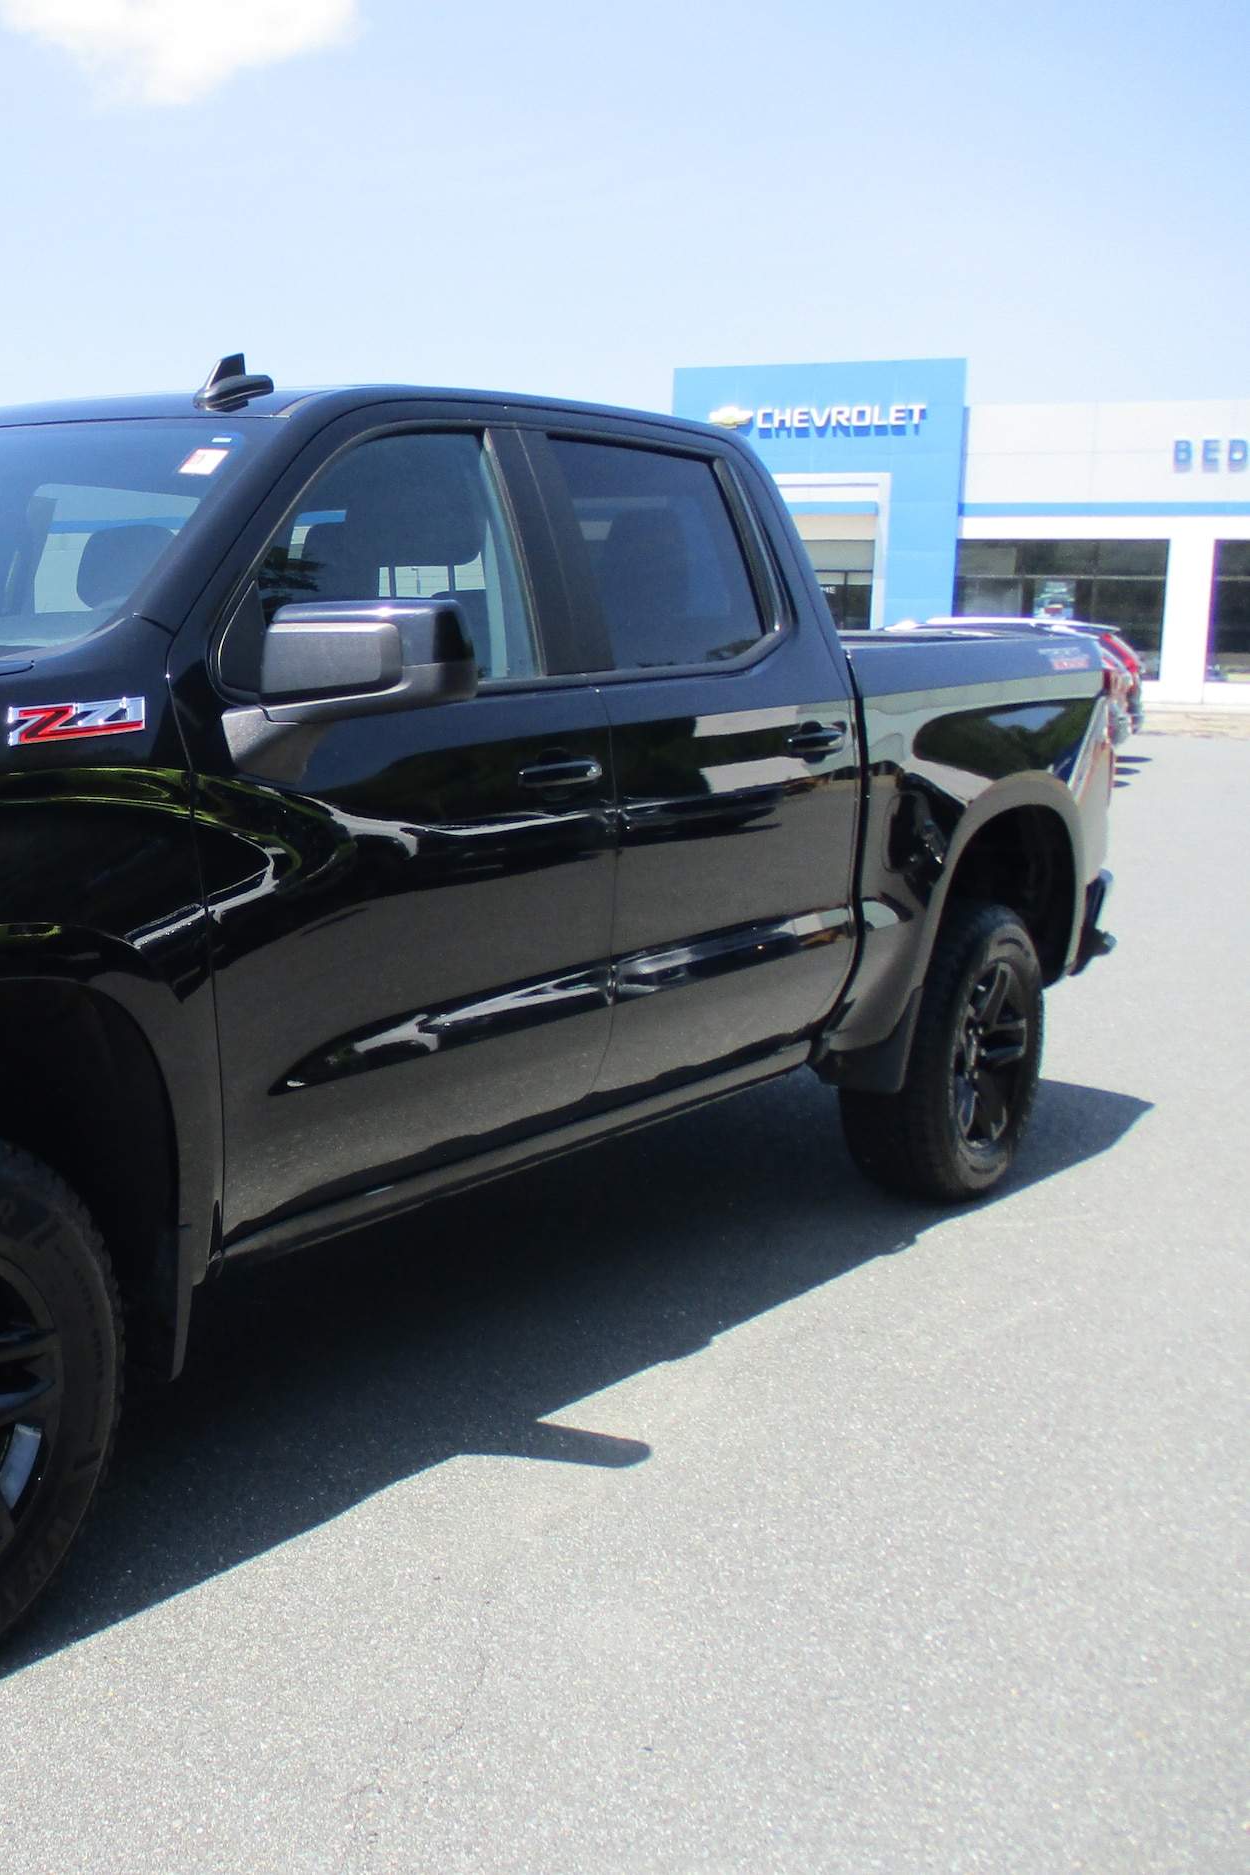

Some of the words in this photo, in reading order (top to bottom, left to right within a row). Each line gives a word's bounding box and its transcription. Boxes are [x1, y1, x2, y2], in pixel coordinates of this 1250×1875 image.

[756, 404, 927, 429] CHEVROLET
[1172, 439, 1249, 463] BED
[8, 697, 146, 746] Z71
